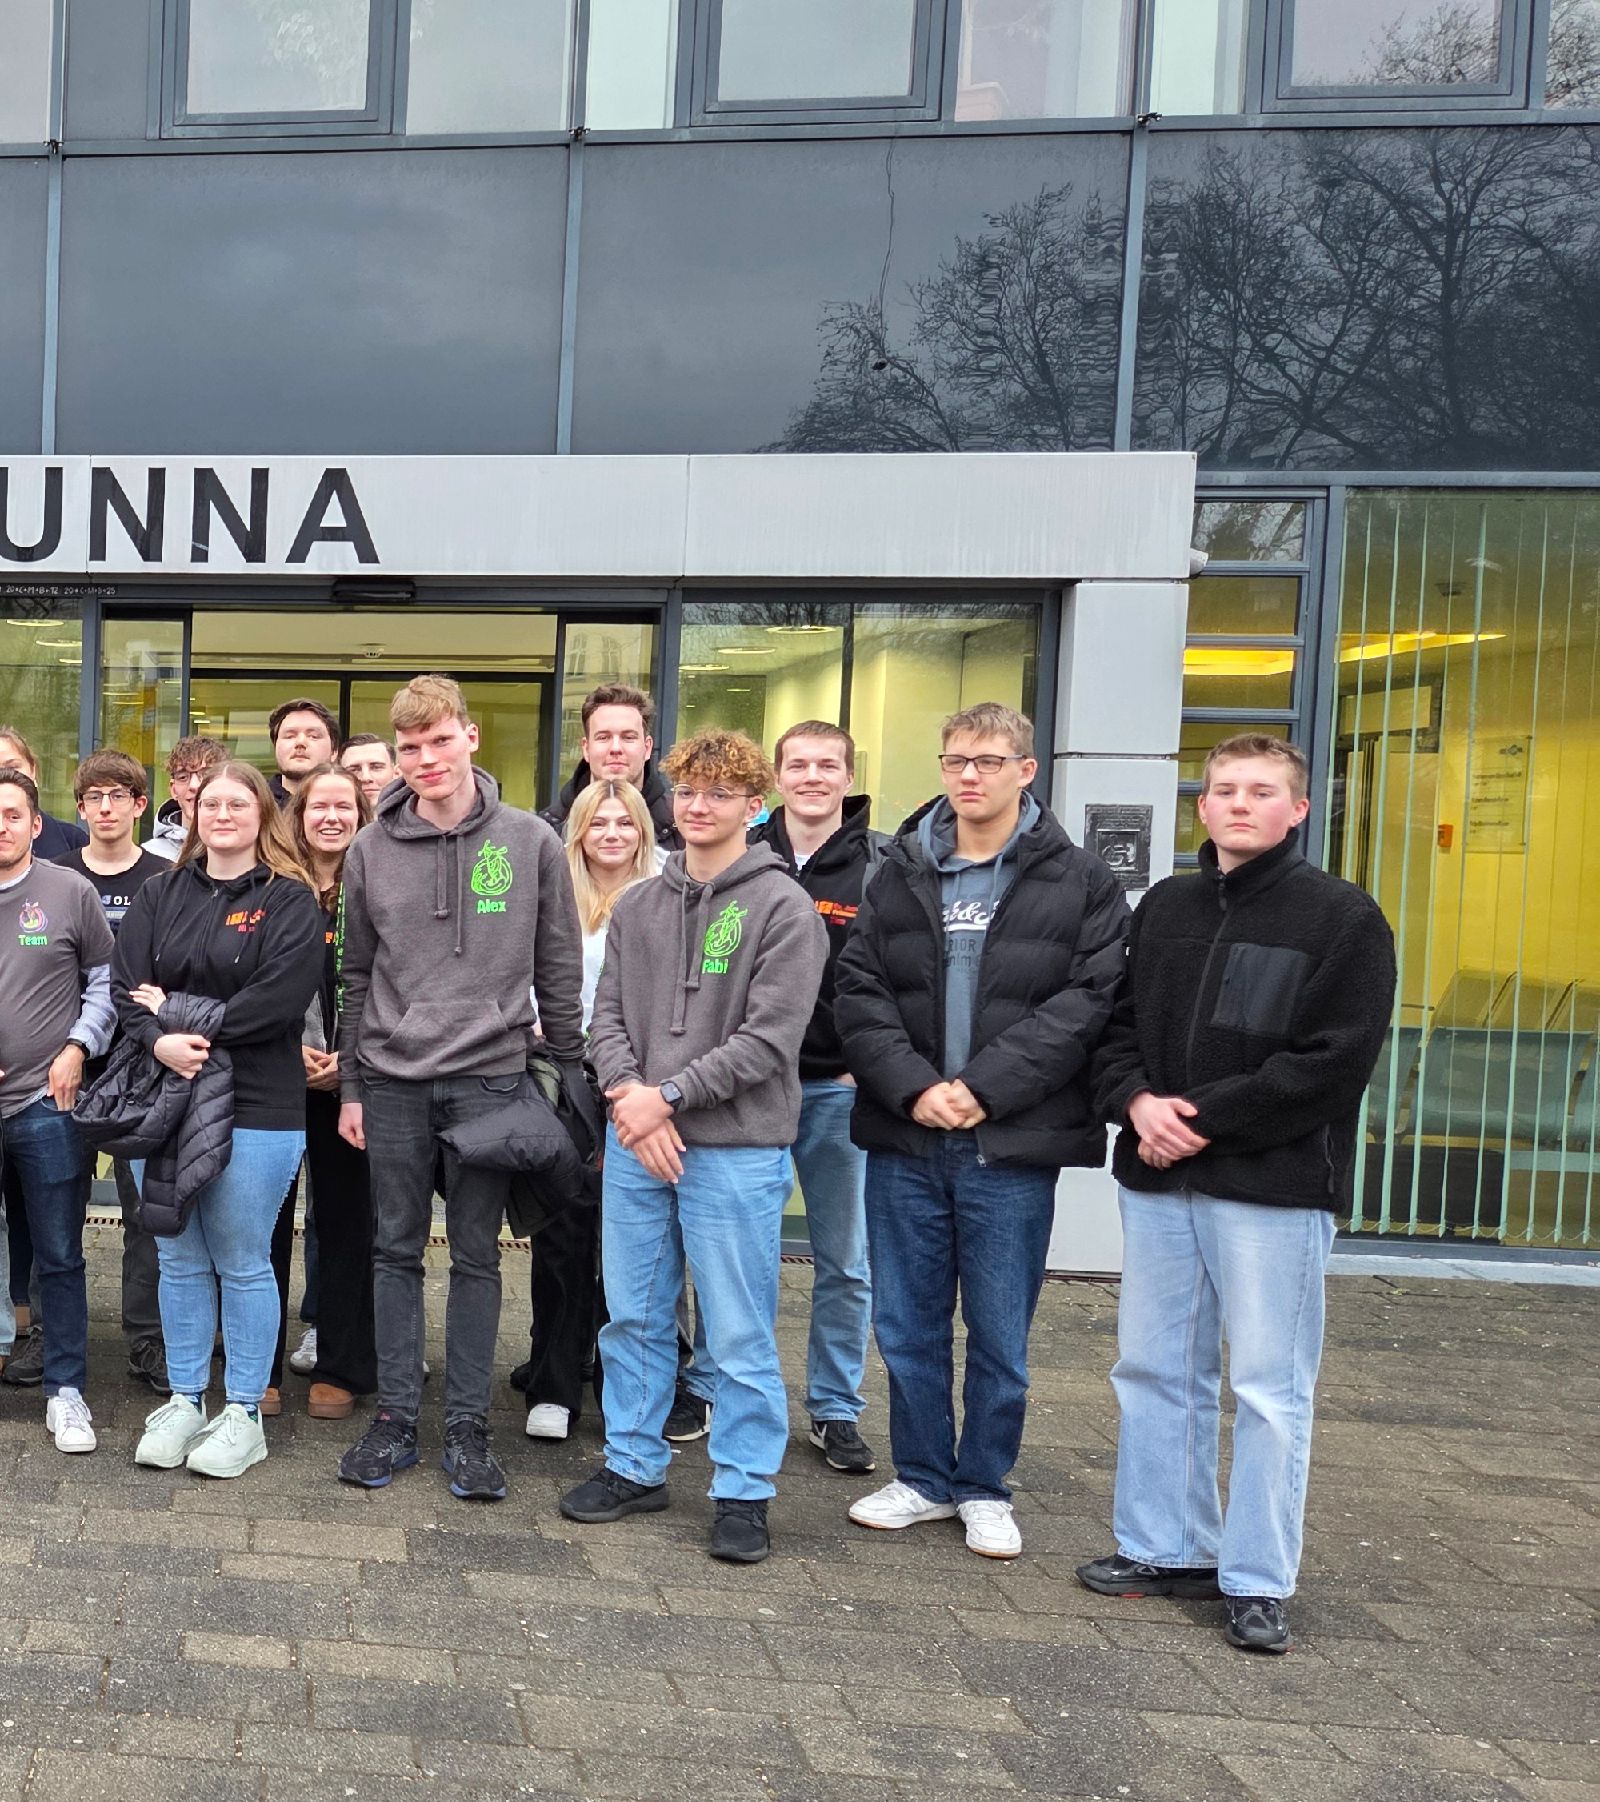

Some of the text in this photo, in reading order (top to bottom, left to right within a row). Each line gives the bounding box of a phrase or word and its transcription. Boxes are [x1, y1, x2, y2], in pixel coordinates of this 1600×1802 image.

[477, 898, 506, 914] Alex
[18, 934, 48, 946] Team
[702, 958, 729, 974] Fabi
